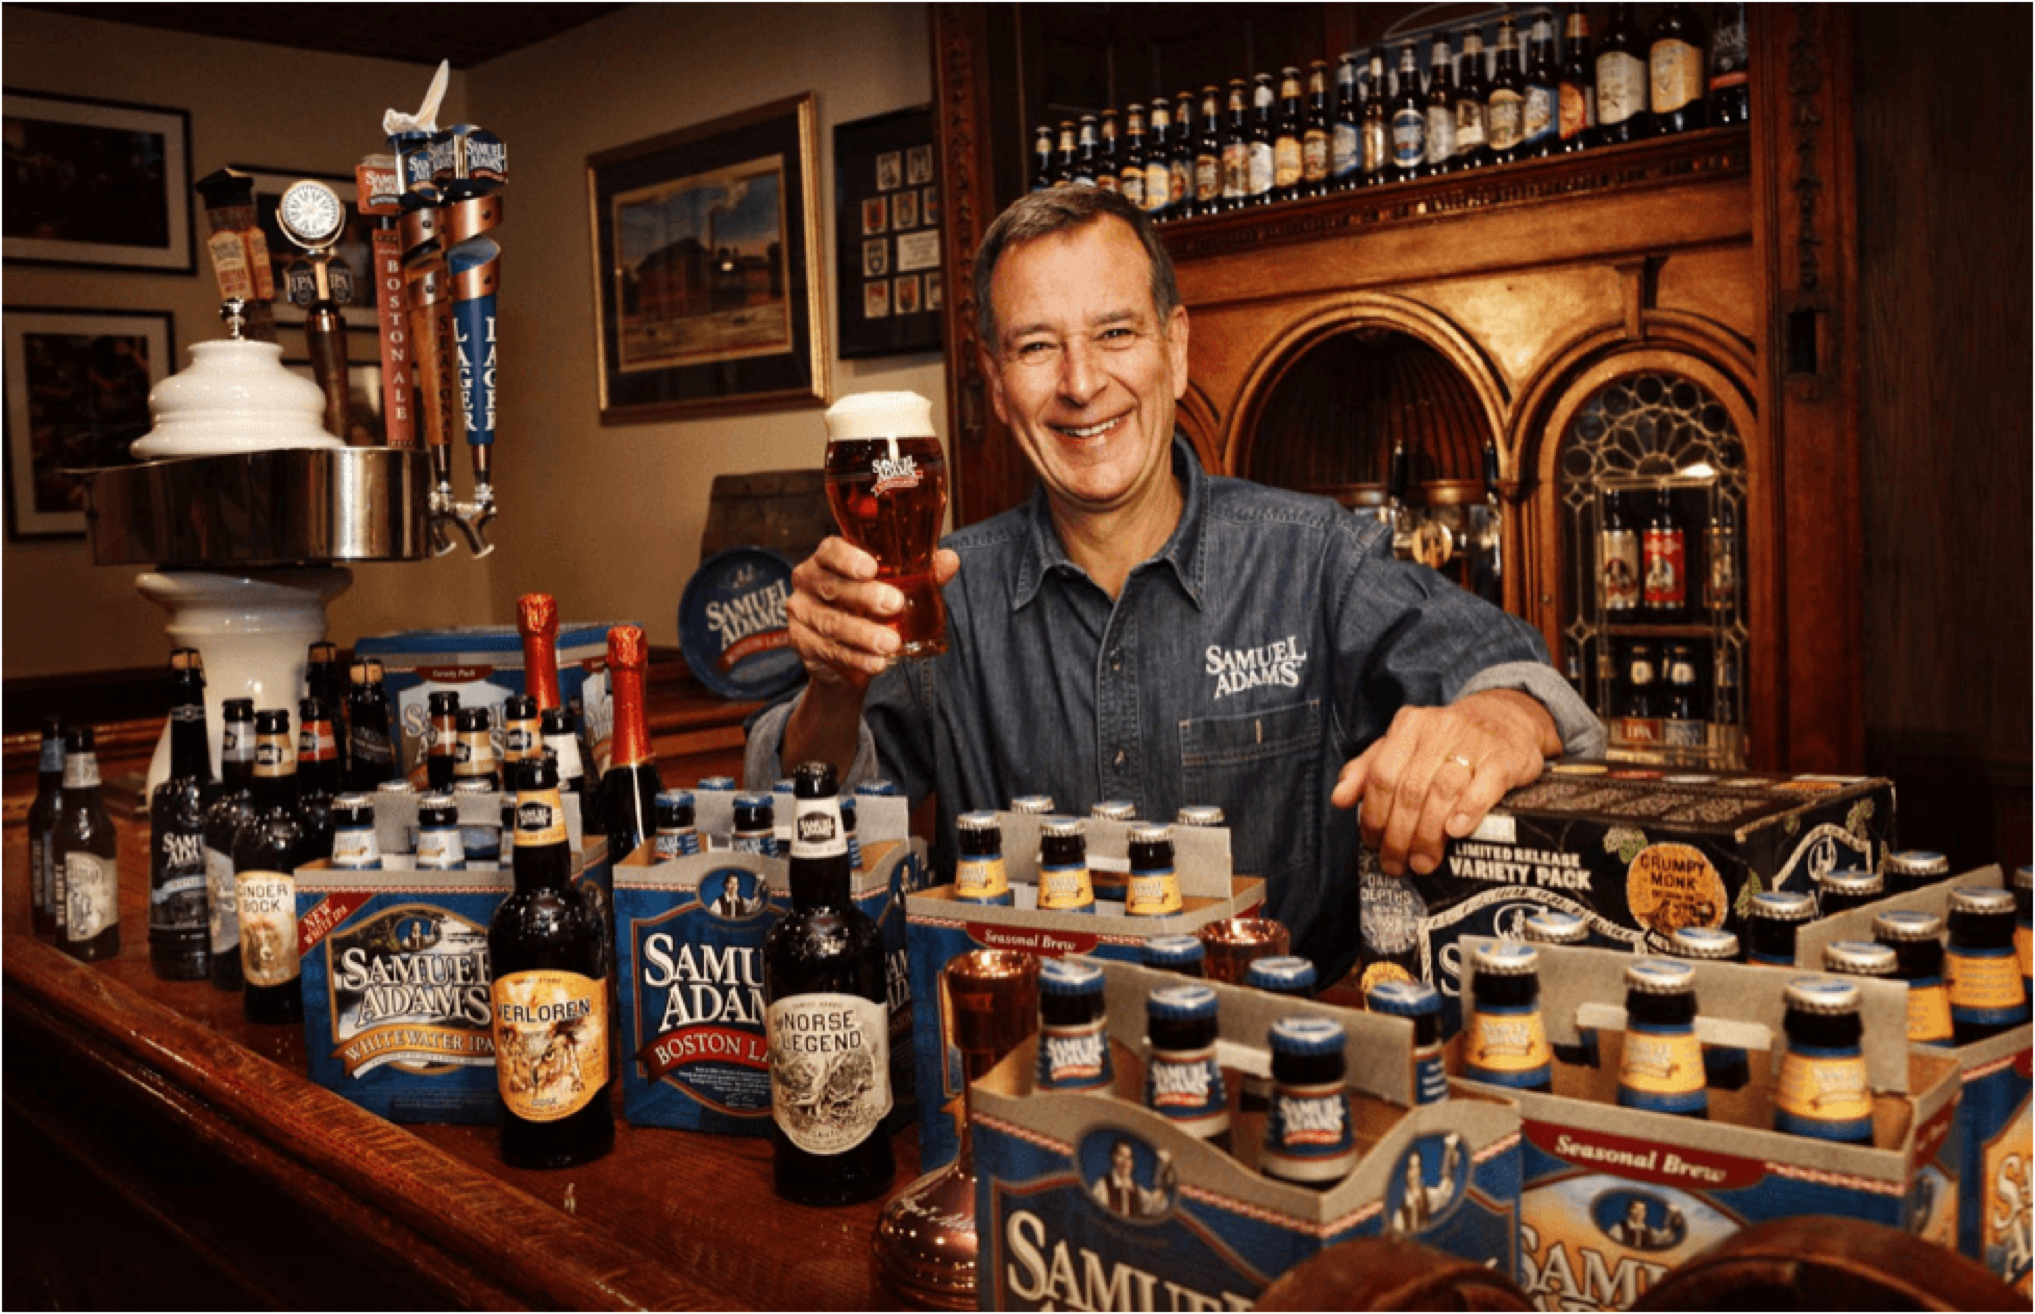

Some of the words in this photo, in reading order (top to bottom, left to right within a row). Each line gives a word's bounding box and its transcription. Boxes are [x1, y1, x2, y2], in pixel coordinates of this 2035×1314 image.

[387, 259, 406, 361] BOSTON
[453, 316, 478, 432] LAGER
[393, 371, 408, 420] ALE
[706, 579, 788, 632] SAMUEL
[1206, 635, 1307, 675] SAMUEL
[1214, 661, 1300, 700] ADAMS
[162, 832, 205, 853] SAM
[166, 848, 205, 868] ADA
[1455, 842, 1513, 861] LIMITED
[1514, 848, 1581, 868] RELEASE
[1449, 856, 1530, 884] VARIETY
[1536, 866, 1592, 890] PACK
[1640, 853, 1706, 876] GRUMPY
[1651, 872, 1696, 890] MONK
[304, 899, 330, 928] NEW
[985, 929, 1038, 947] Seasonal
[1042, 936, 1077, 951] Brew
[354, 984, 492, 1030] ADAMS
[784, 1010, 855, 1032] NORSE
[654, 1032, 741, 1066] BOSTON
[747, 1040, 769, 1063] L
[781, 1031, 861, 1052] LEGEND
[1556, 1134, 1658, 1170] Seasonal
[1662, 1153, 1727, 1183] Brew
[1006, 1209, 1255, 1313] SAMU
[1520, 1222, 1670, 1311] SAM
